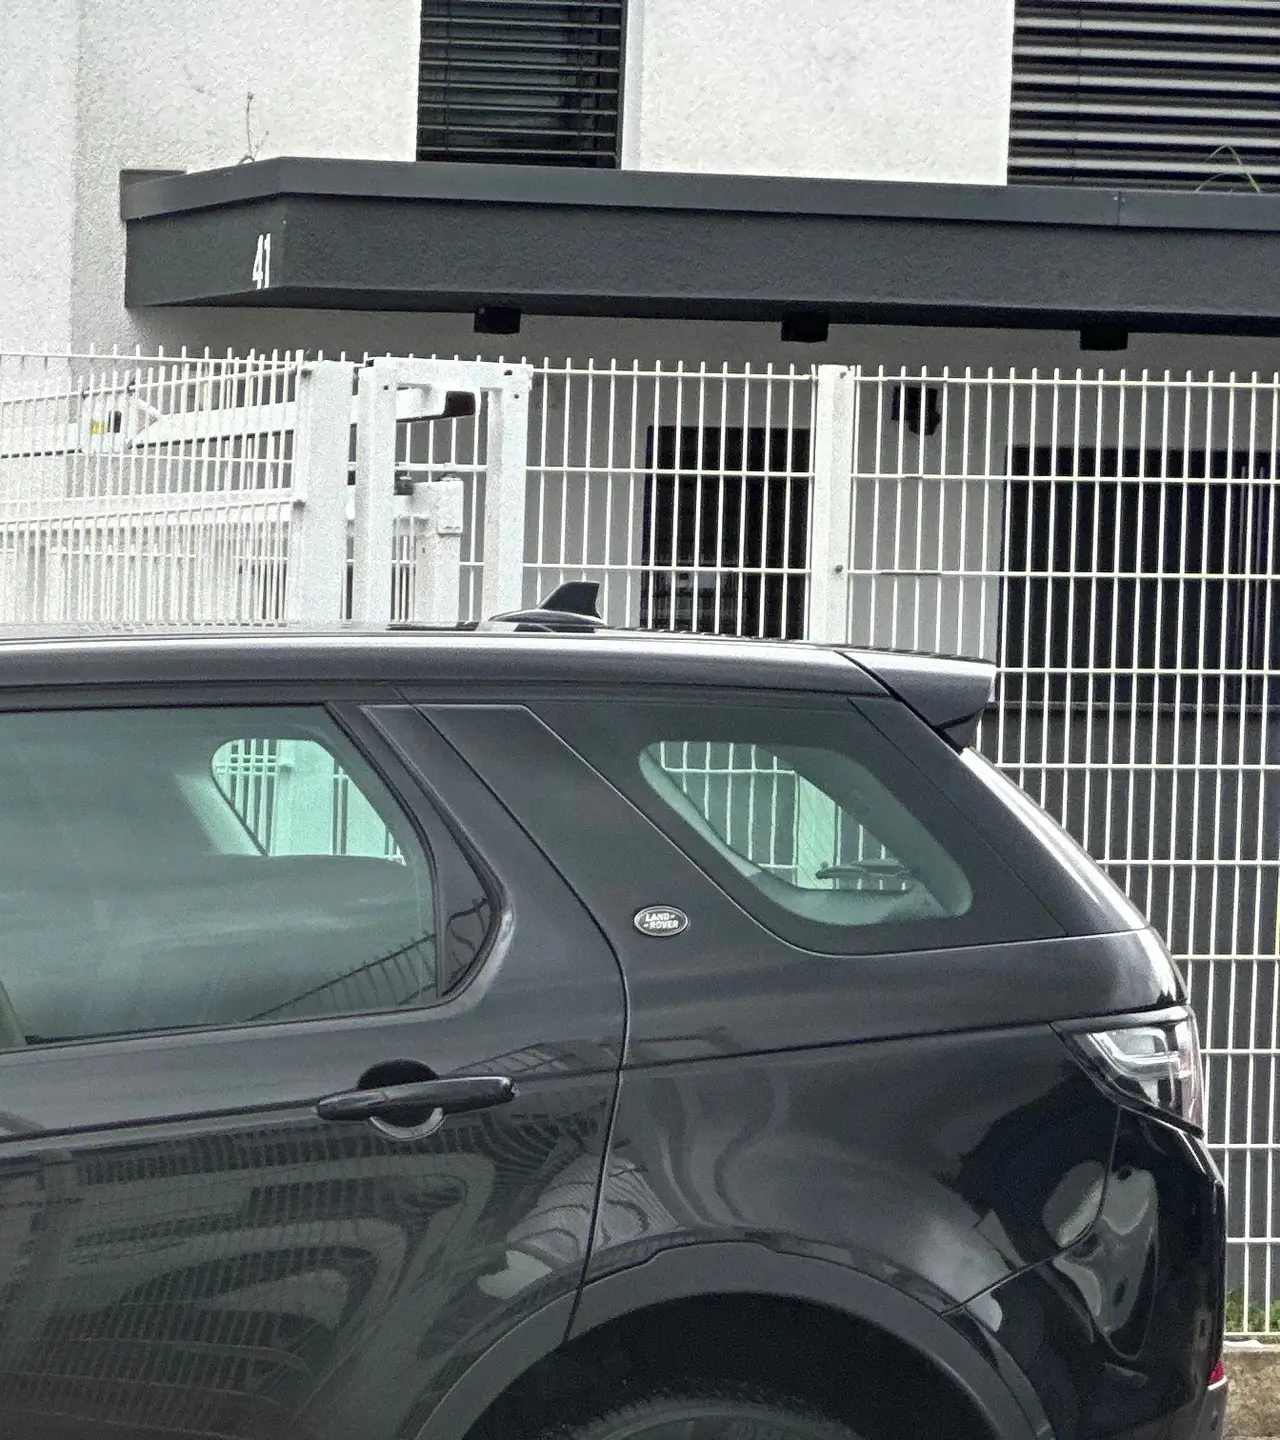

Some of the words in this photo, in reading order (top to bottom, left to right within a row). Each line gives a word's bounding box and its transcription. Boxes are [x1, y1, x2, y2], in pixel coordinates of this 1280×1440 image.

[252, 233, 271, 290] 41
[645, 912, 670, 922] LAND
[650, 919, 679, 929] ROVER
